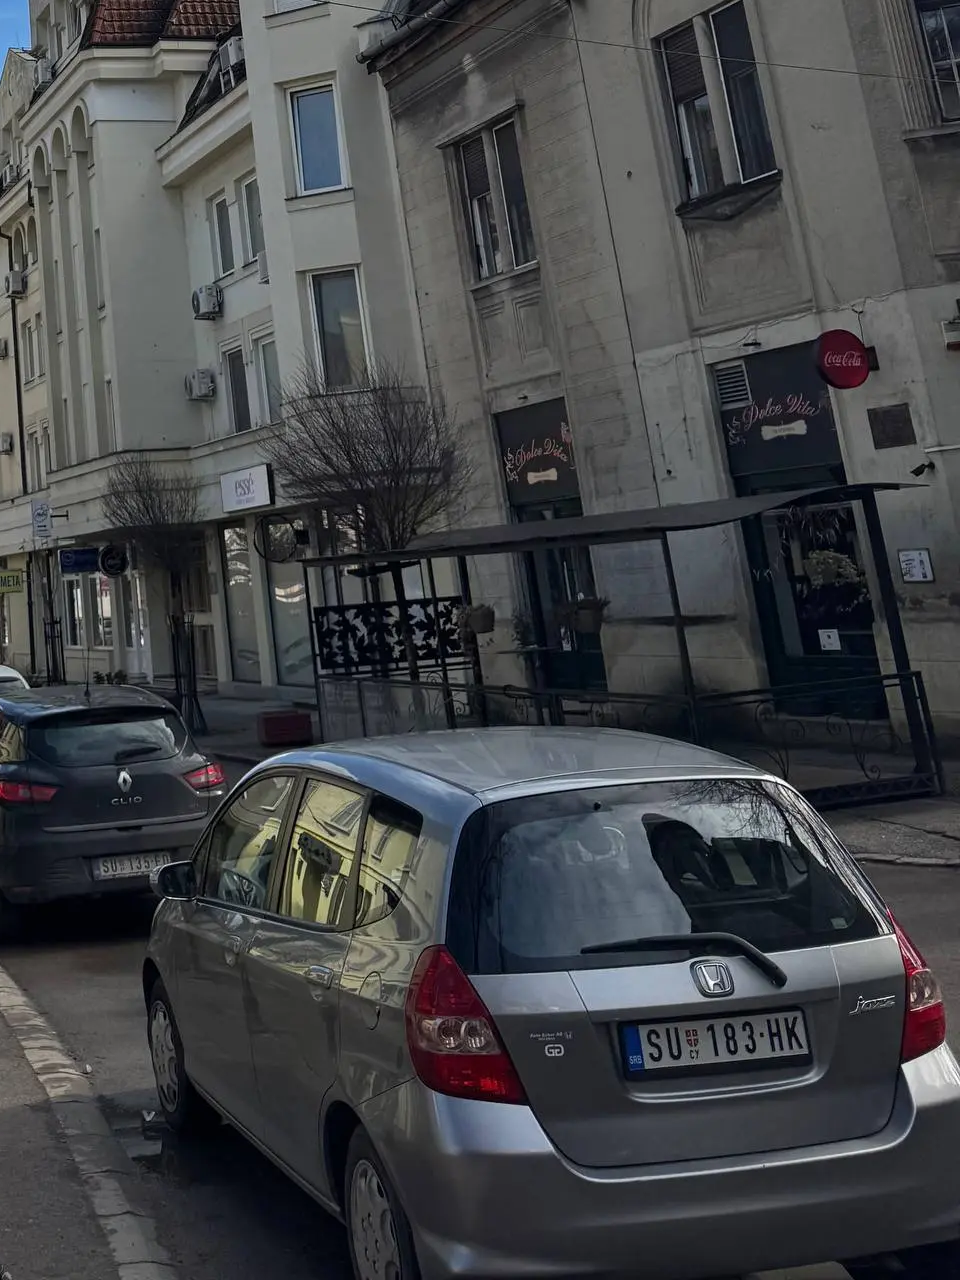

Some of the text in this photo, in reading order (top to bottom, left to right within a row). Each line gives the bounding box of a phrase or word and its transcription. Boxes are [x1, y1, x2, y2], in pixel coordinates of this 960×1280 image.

[742, 393, 821, 431] Dolce Vita
[515, 438, 543, 472] Dolce
[111, 796, 142, 805] CLIO
[102, 858, 118, 874] SU
[646, 1027, 682, 1062] SU
[629, 1055, 643, 1065] SRB
